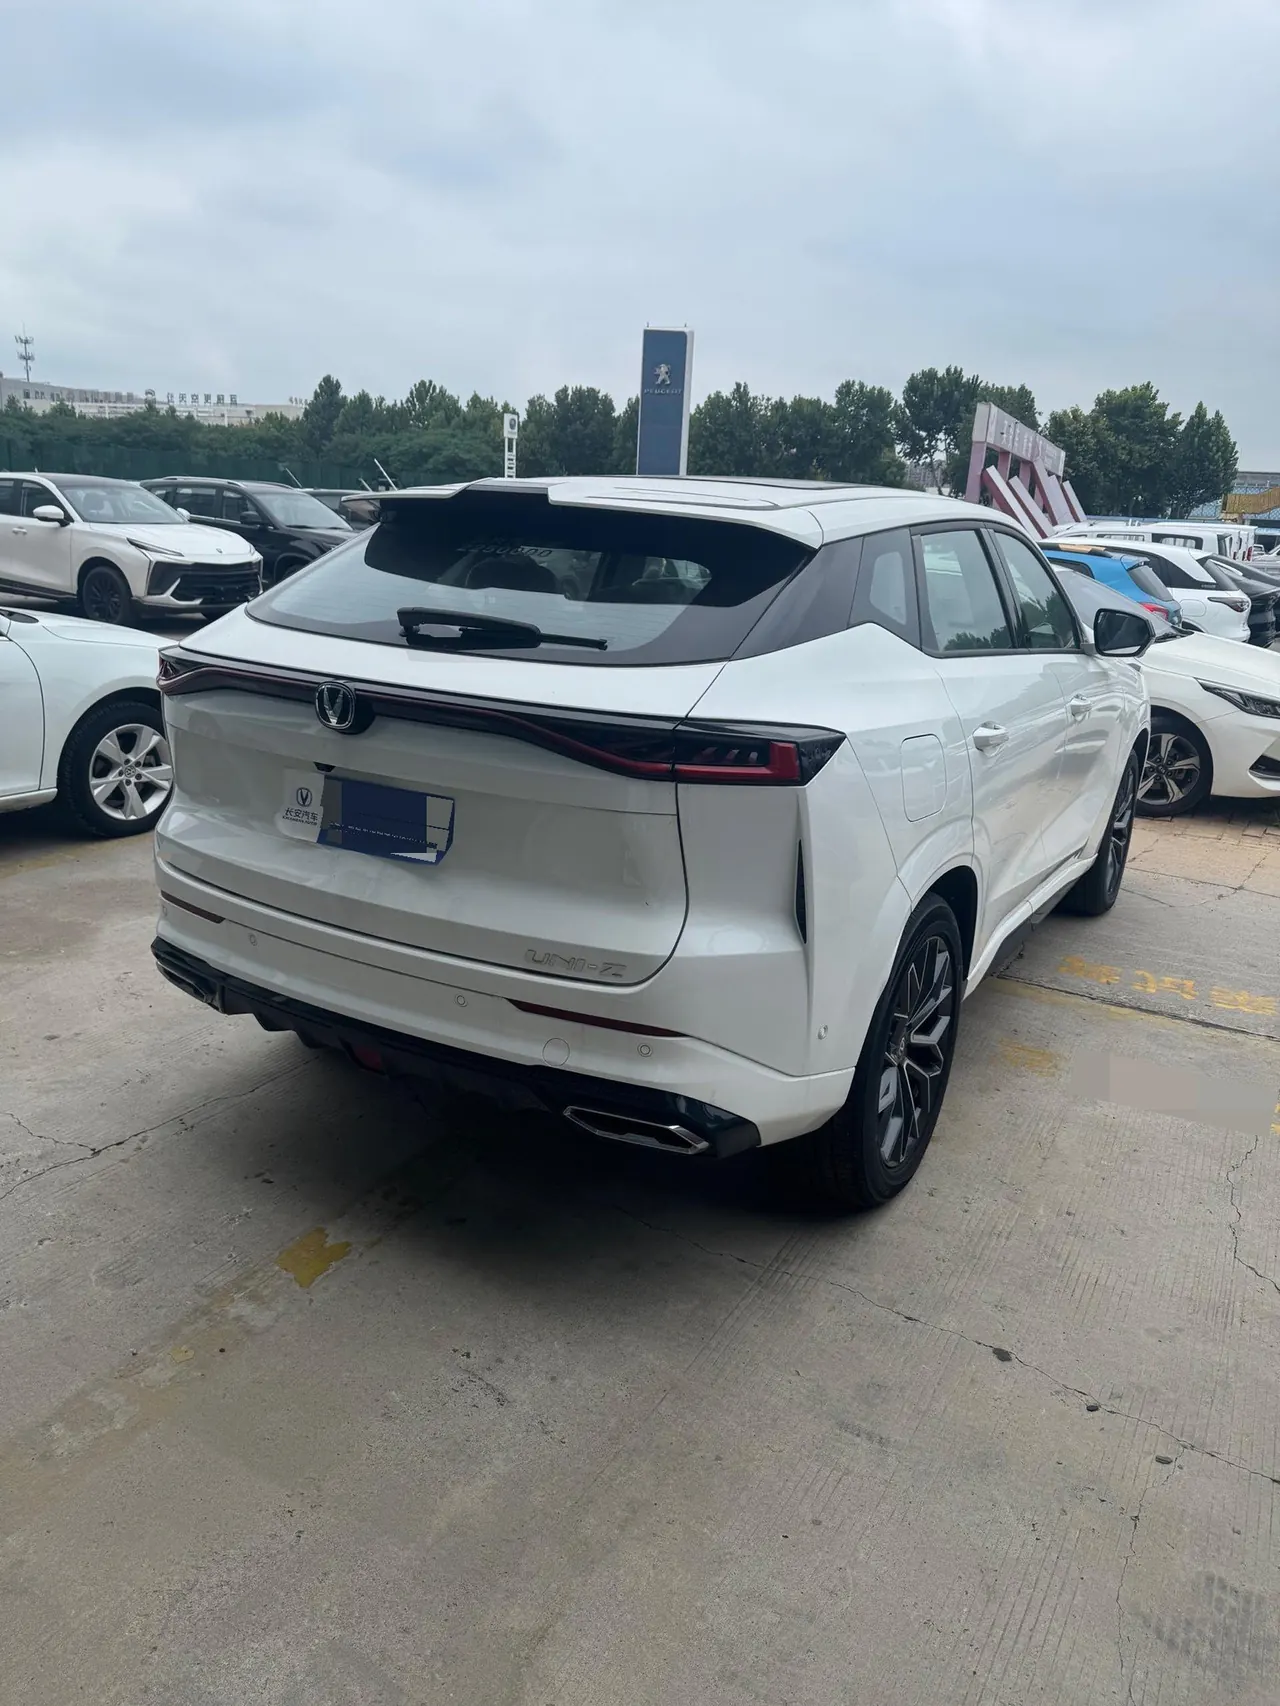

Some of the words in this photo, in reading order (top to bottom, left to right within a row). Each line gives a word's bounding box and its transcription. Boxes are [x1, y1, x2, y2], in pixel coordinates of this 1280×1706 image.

[284, 807, 318, 822] 长安汽车
[524, 949, 627, 978] UNI-Z
